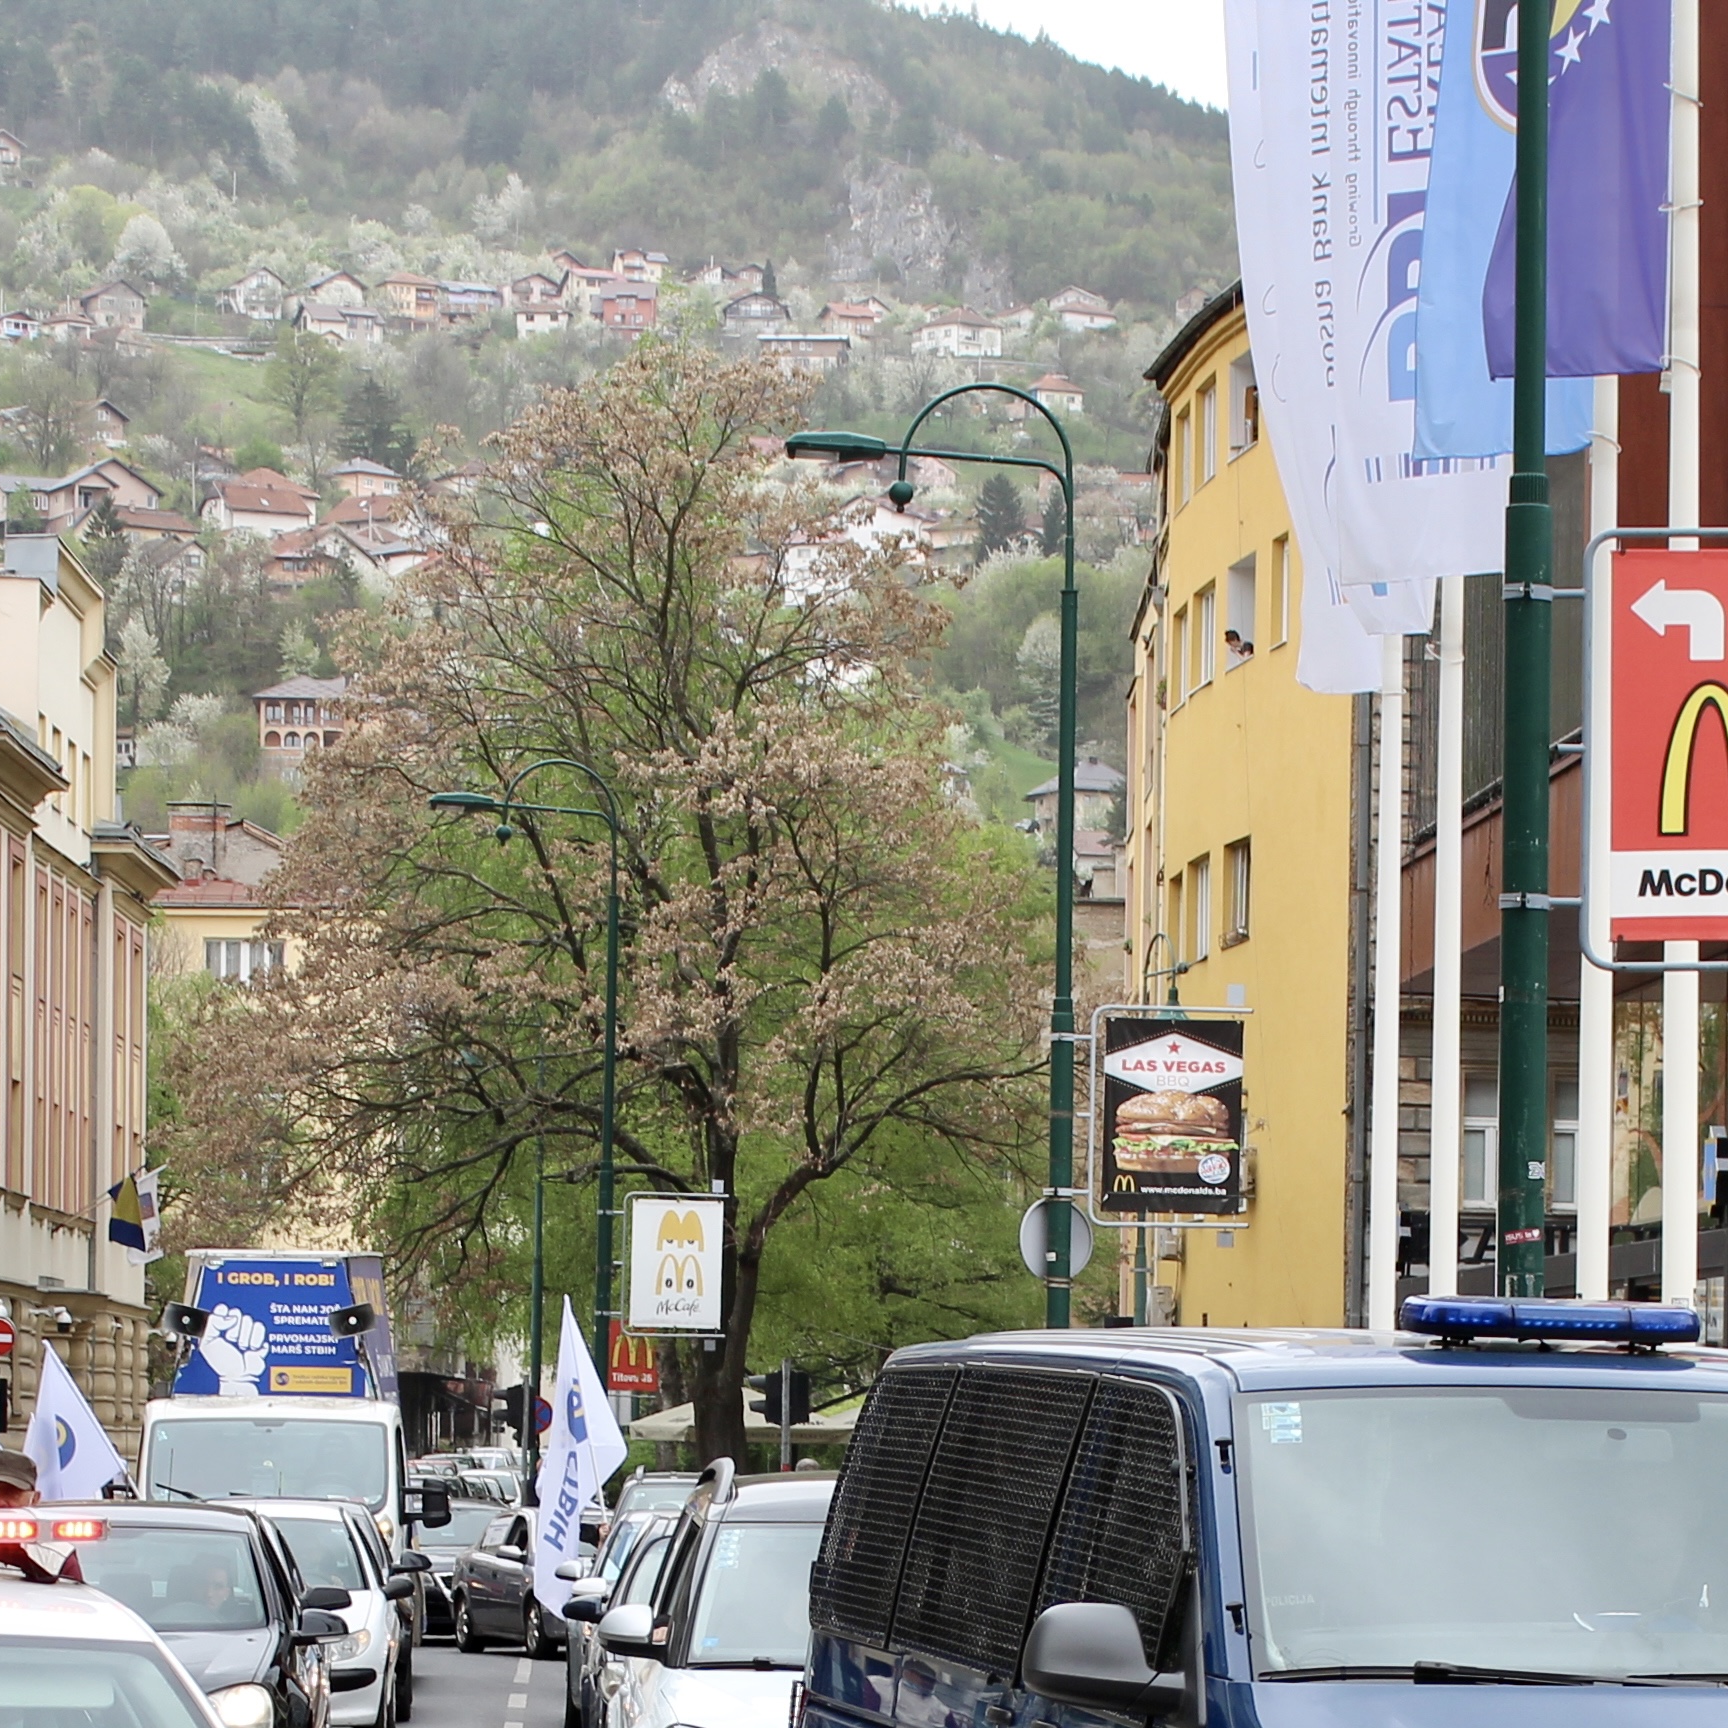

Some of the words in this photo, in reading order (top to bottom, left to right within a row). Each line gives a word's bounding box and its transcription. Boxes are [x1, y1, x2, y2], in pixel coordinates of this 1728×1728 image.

[1122, 1059, 1157, 1073] LAS
[1163, 1060, 1226, 1074] VEGAS
[1156, 1075, 1190, 1088] BBQ
[1140, 1184, 1227, 1196] www.mcdonalds.ba
[217, 1272, 223, 1285] I
[227, 1272, 280, 1287] GROB,
[284, 1274, 290, 1286] I
[294, 1273, 335, 1286] ROB!
[269, 1302, 291, 1314] ŠTA
[292, 1304, 318, 1315] NAM
[656, 1298, 701, 1317] McCafé
[271, 1344, 303, 1355] MARŠ
[304, 1345, 336, 1355] STBIH
